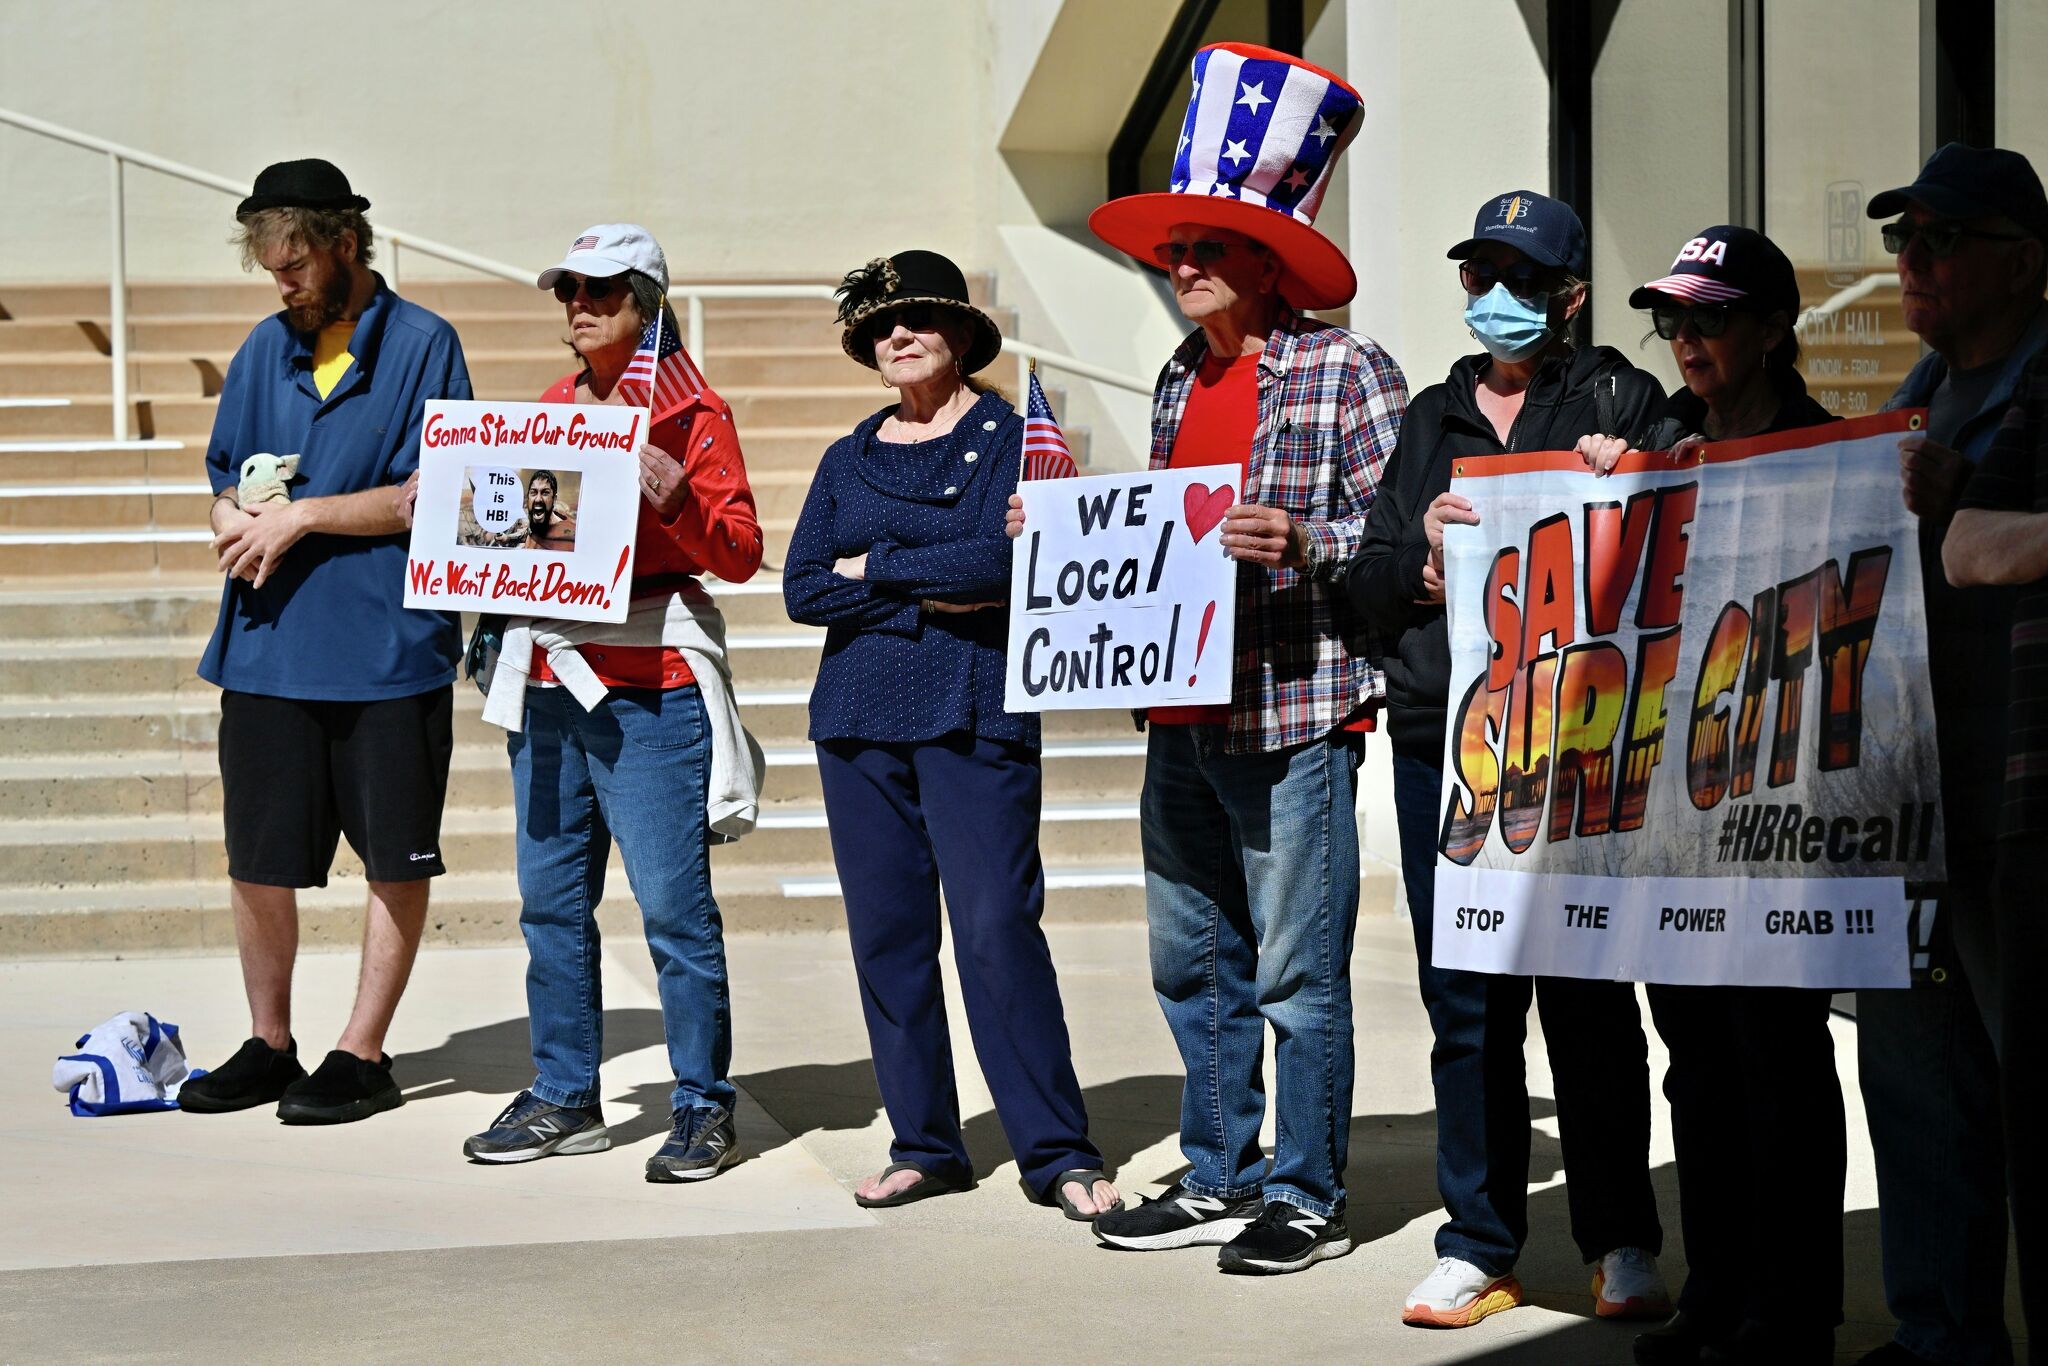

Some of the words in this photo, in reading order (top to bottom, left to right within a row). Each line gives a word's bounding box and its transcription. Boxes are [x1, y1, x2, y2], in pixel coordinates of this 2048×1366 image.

[1806, 310, 1839, 345] CITY
[1845, 311, 1885, 345] HALL
[1808, 359, 1842, 376] MONDAY
[1851, 359, 1880, 377] FRIDAY
[1848, 392, 1868, 410] 5:00
[425, 413, 477, 448] Gonna
[480, 412, 531, 447] Stand
[532, 412, 566, 446] Our
[567, 412, 640, 452] Ground
[488, 472, 515, 486] This
[493, 492, 504, 503] is
[486, 509, 508, 522] HB!
[1078, 483, 1153, 536] WE
[410, 559, 442, 595] We
[492, 563, 541, 601] Back
[1026, 521, 1175, 611] Local
[1483, 480, 1698, 692] SAVE
[1439, 623, 1682, 866] SURF
[1686, 545, 1893, 811] CITY
[1717, 803, 1936, 863] #HBRecall
[1455, 906, 1505, 932] STOP
[1564, 904, 1610, 929] THE
[1659, 907, 1727, 932] POWER
[1765, 910, 1834, 935] GRAB
